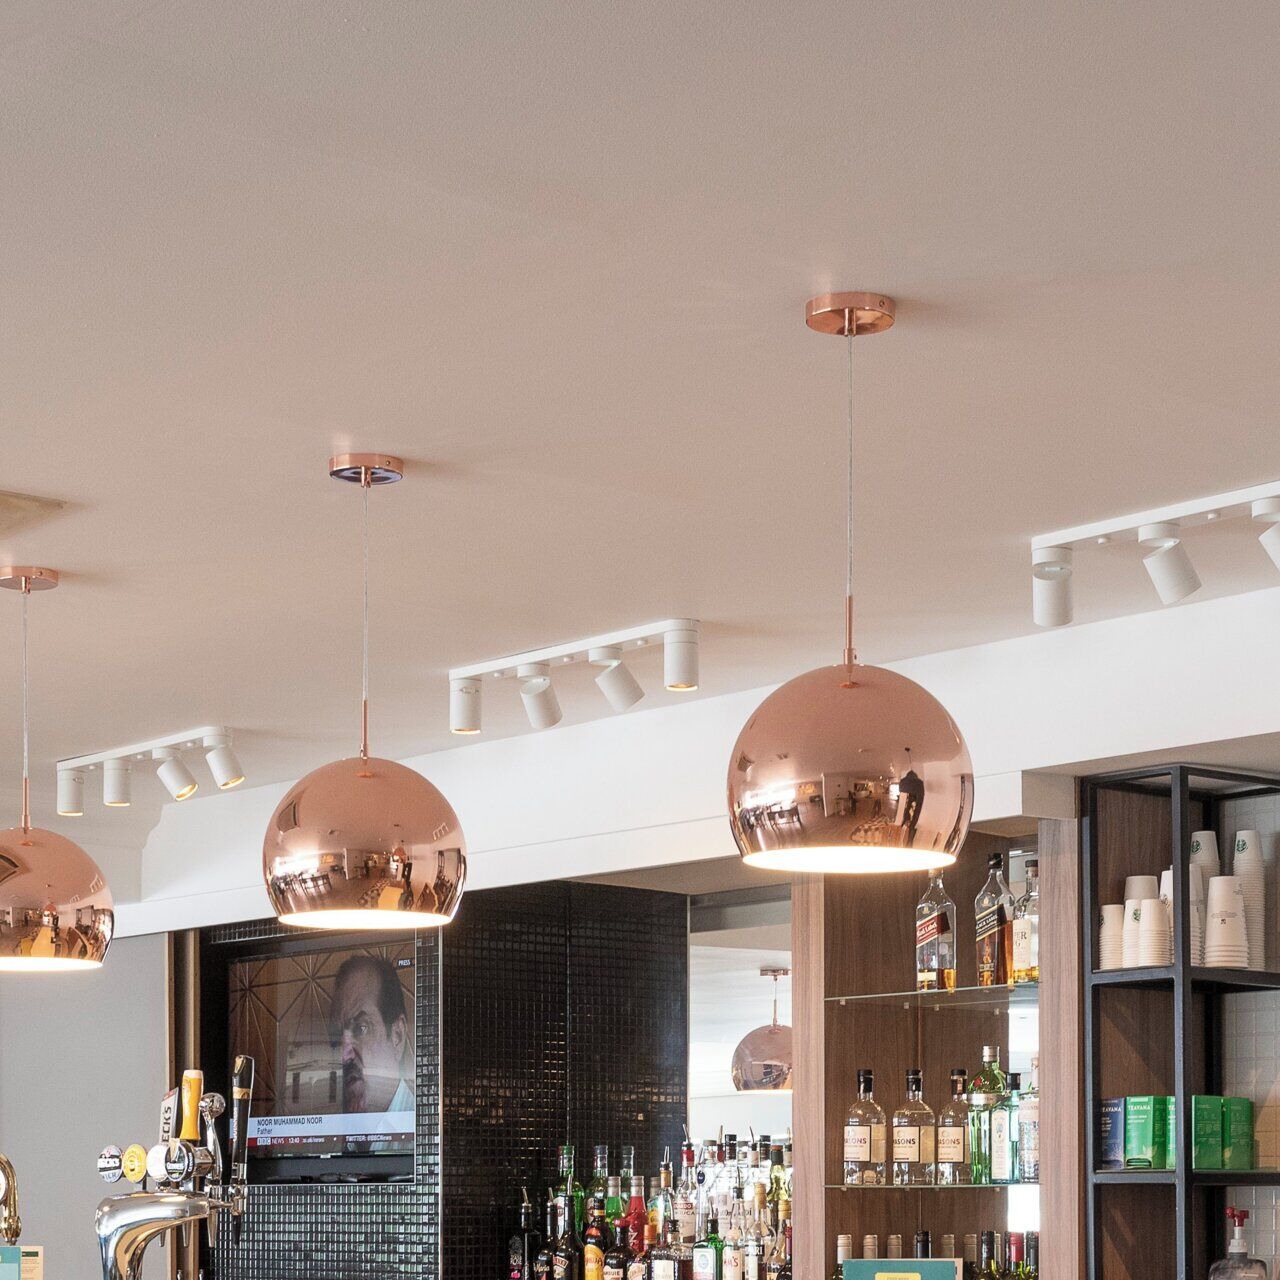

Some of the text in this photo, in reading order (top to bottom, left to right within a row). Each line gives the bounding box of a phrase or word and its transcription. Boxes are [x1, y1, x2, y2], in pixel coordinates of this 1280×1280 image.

[257, 1116, 323, 1127] NOOR MUHAMMAD NOOR
[257, 1127, 272, 1135] Father
